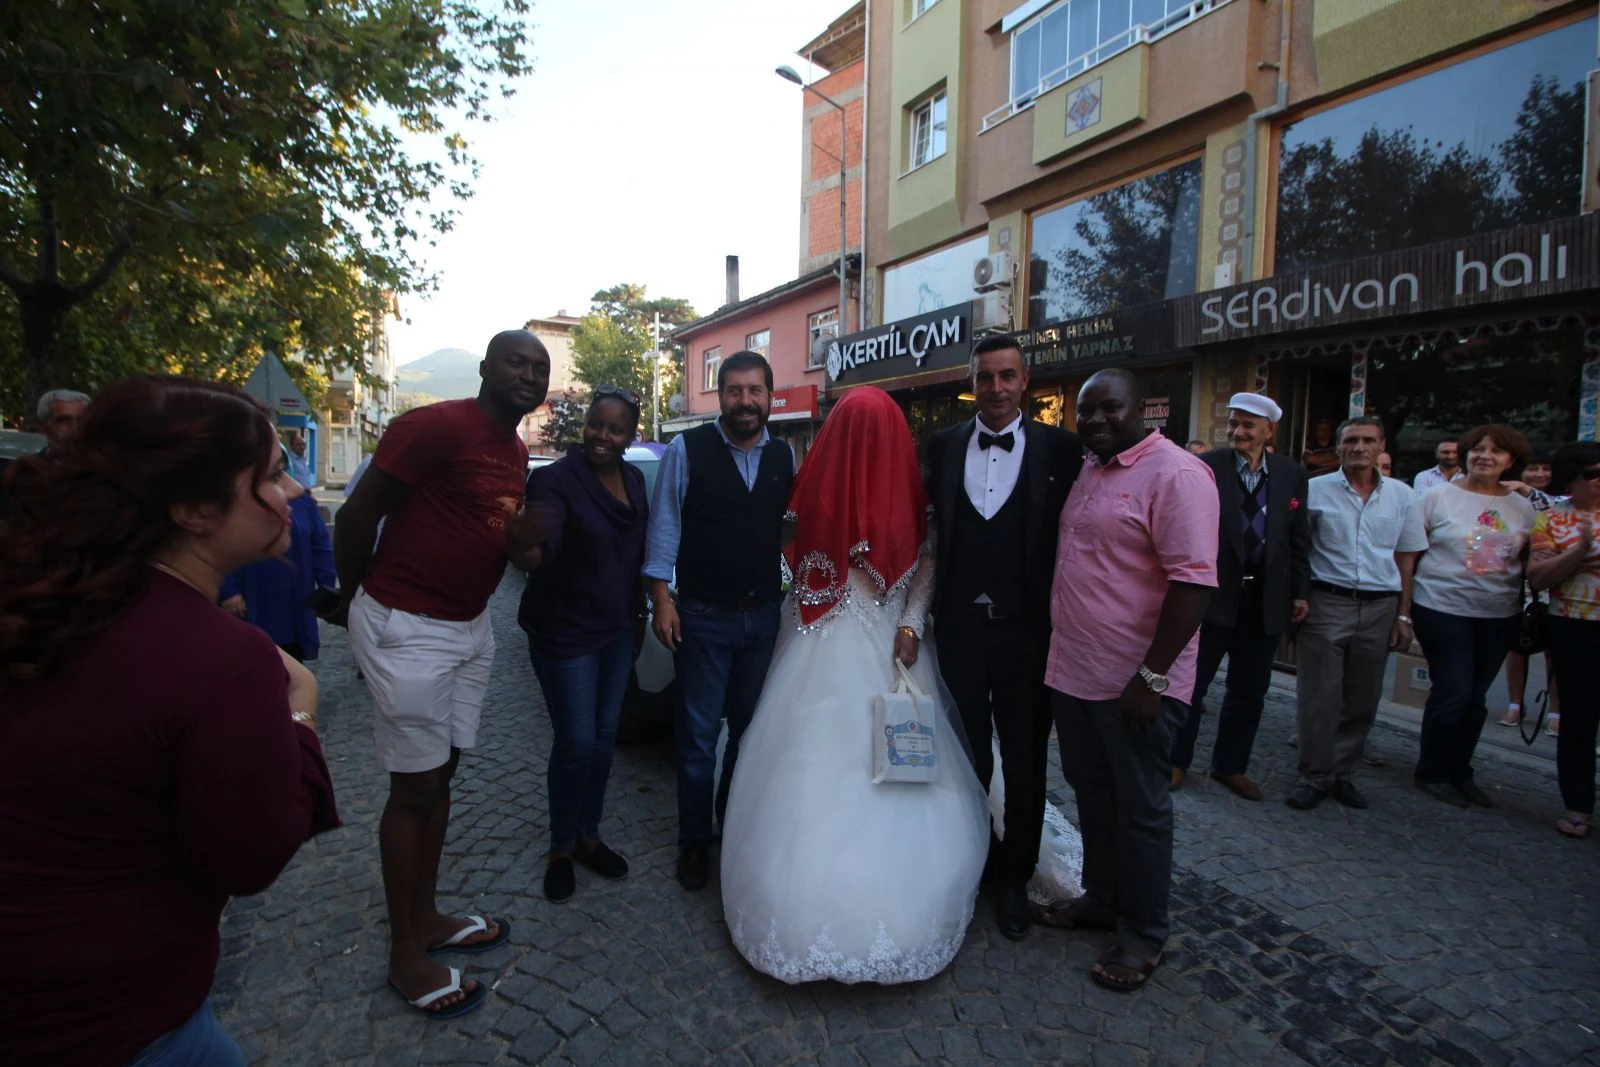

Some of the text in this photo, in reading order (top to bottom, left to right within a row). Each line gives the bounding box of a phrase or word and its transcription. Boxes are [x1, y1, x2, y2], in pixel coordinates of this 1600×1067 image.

[1202, 233, 1567, 334] SERdivan halı
[842, 315, 960, 371] KERTİL ÇAM
[1016, 327, 1061, 348] ERİNER
[772, 397, 787, 408] fone
